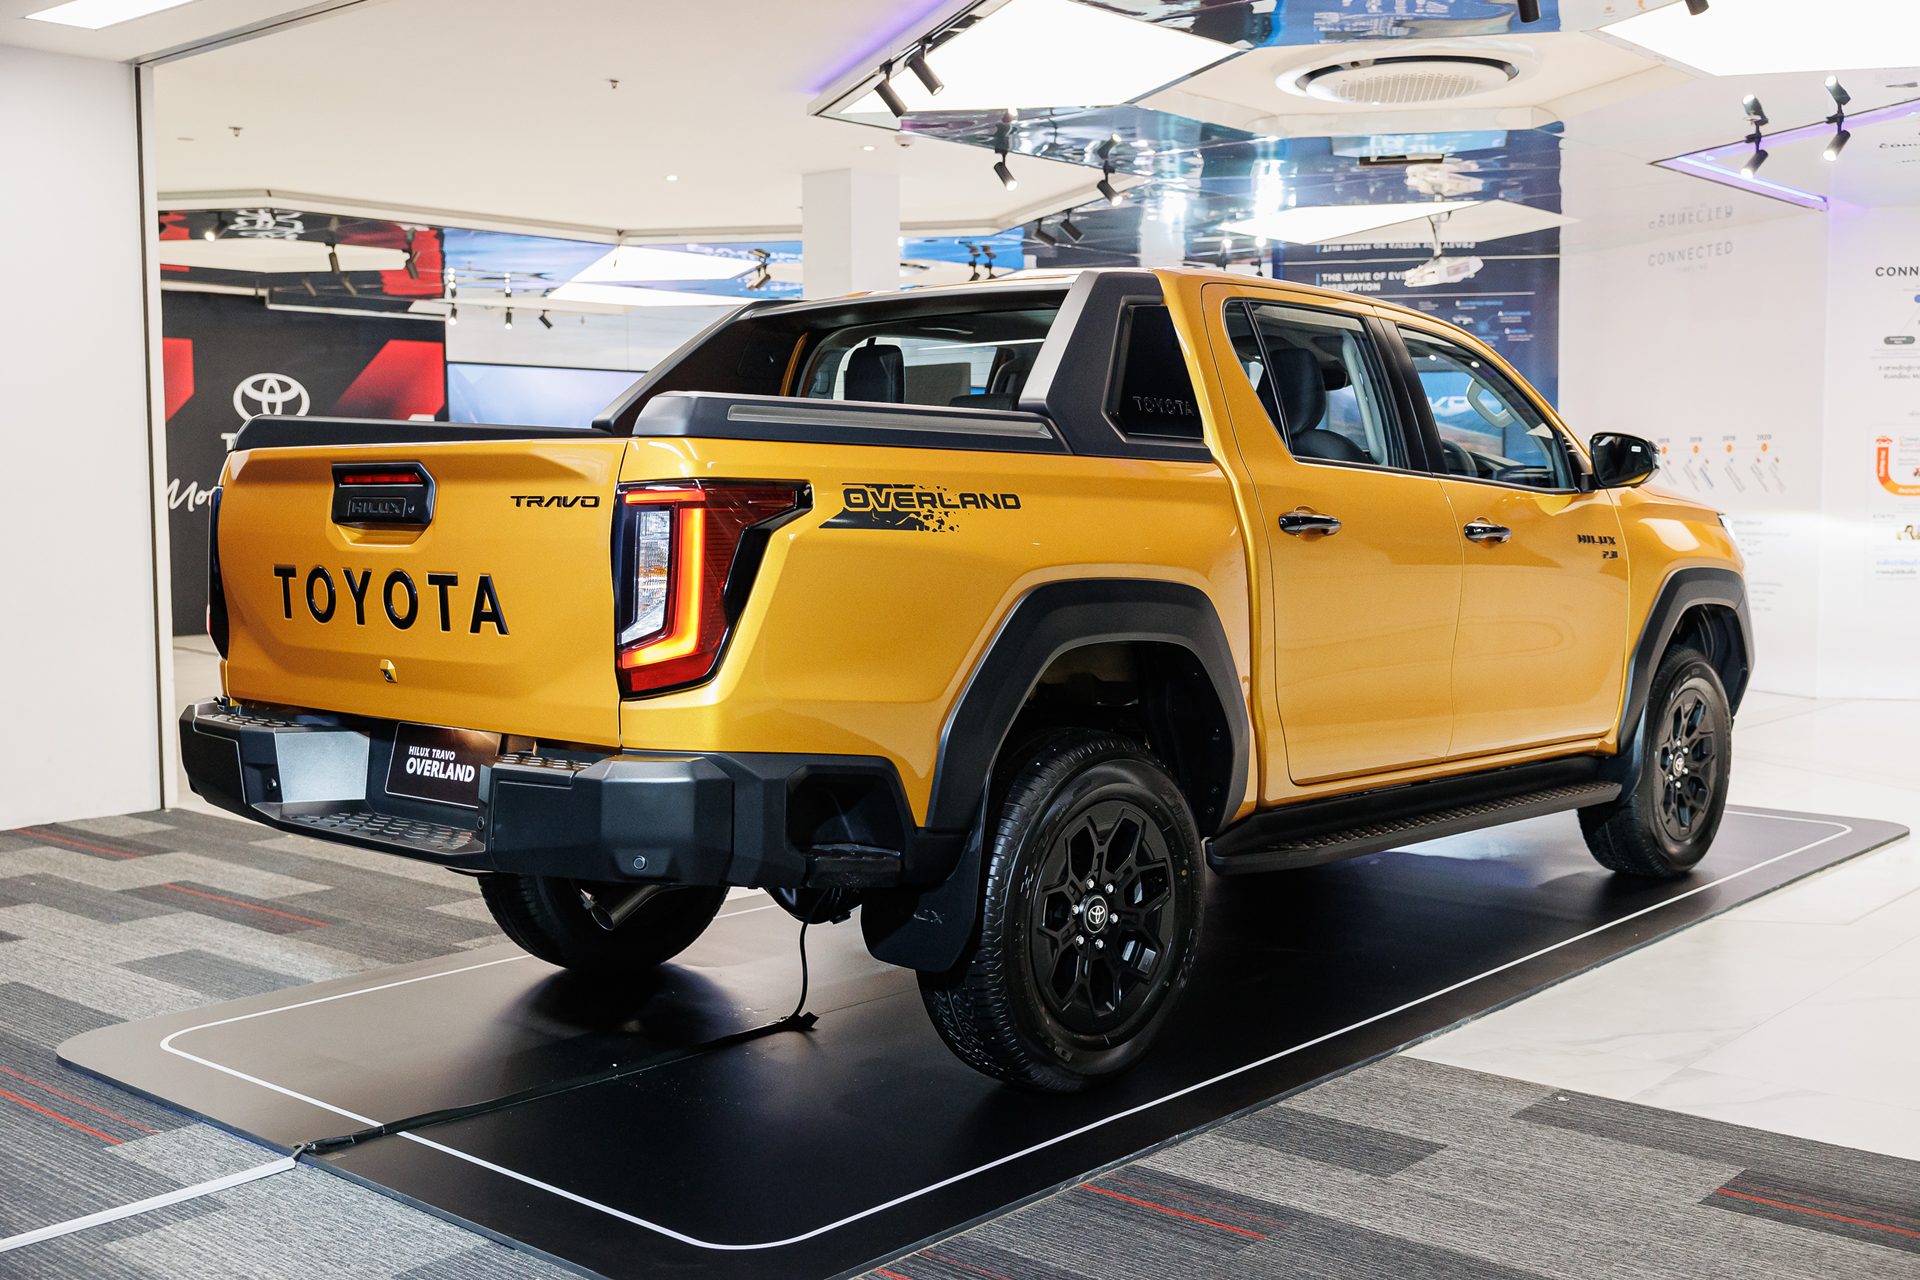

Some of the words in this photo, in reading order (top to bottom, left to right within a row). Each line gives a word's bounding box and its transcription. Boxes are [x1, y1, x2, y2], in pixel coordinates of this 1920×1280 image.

[1647, 241, 1733, 267] CONNECTED
[1321, 272, 1342, 281] THE
[1343, 272, 1371, 281] WAVE
[1373, 271, 1387, 280] OF
[1132, 395, 1195, 417] TOYOTA
[351, 501, 401, 514] HILUX
[510, 495, 600, 508] TRAVO
[843, 487, 1022, 510] OVERLAND
[1577, 534, 1616, 545] HILUX
[273, 564, 510, 635] TOYOTA
[408, 745, 430, 757] HILUX
[431, 748, 456, 760] TRAVO
[405, 757, 475, 782] OVERLAND
